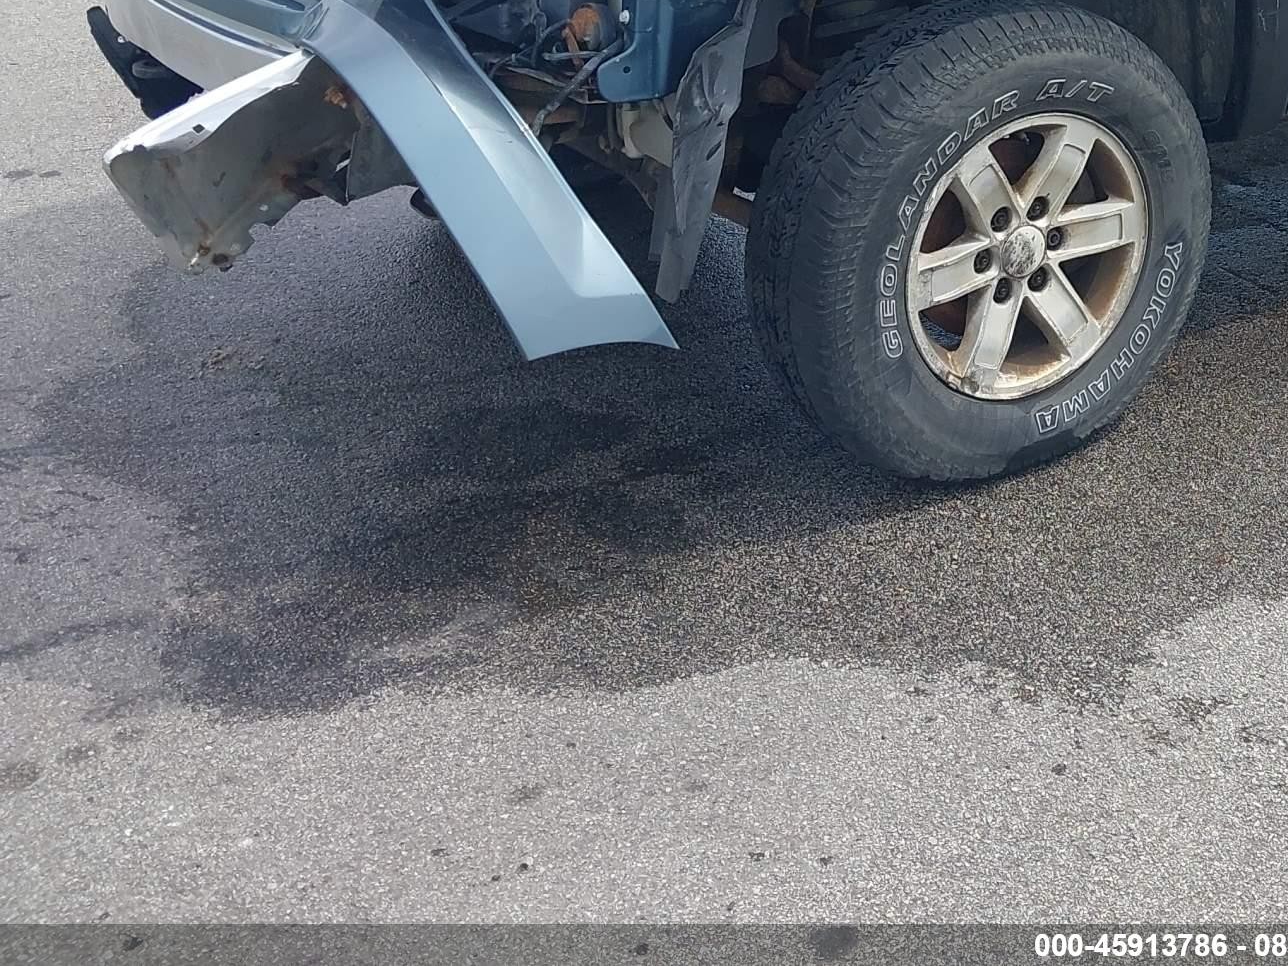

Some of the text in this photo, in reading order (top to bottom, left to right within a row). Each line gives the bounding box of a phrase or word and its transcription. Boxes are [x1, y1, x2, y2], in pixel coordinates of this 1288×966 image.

[879, 79, 1115, 360] GEOLANDAR A/T
[1034, 240, 1185, 434] YOKOHAMA
